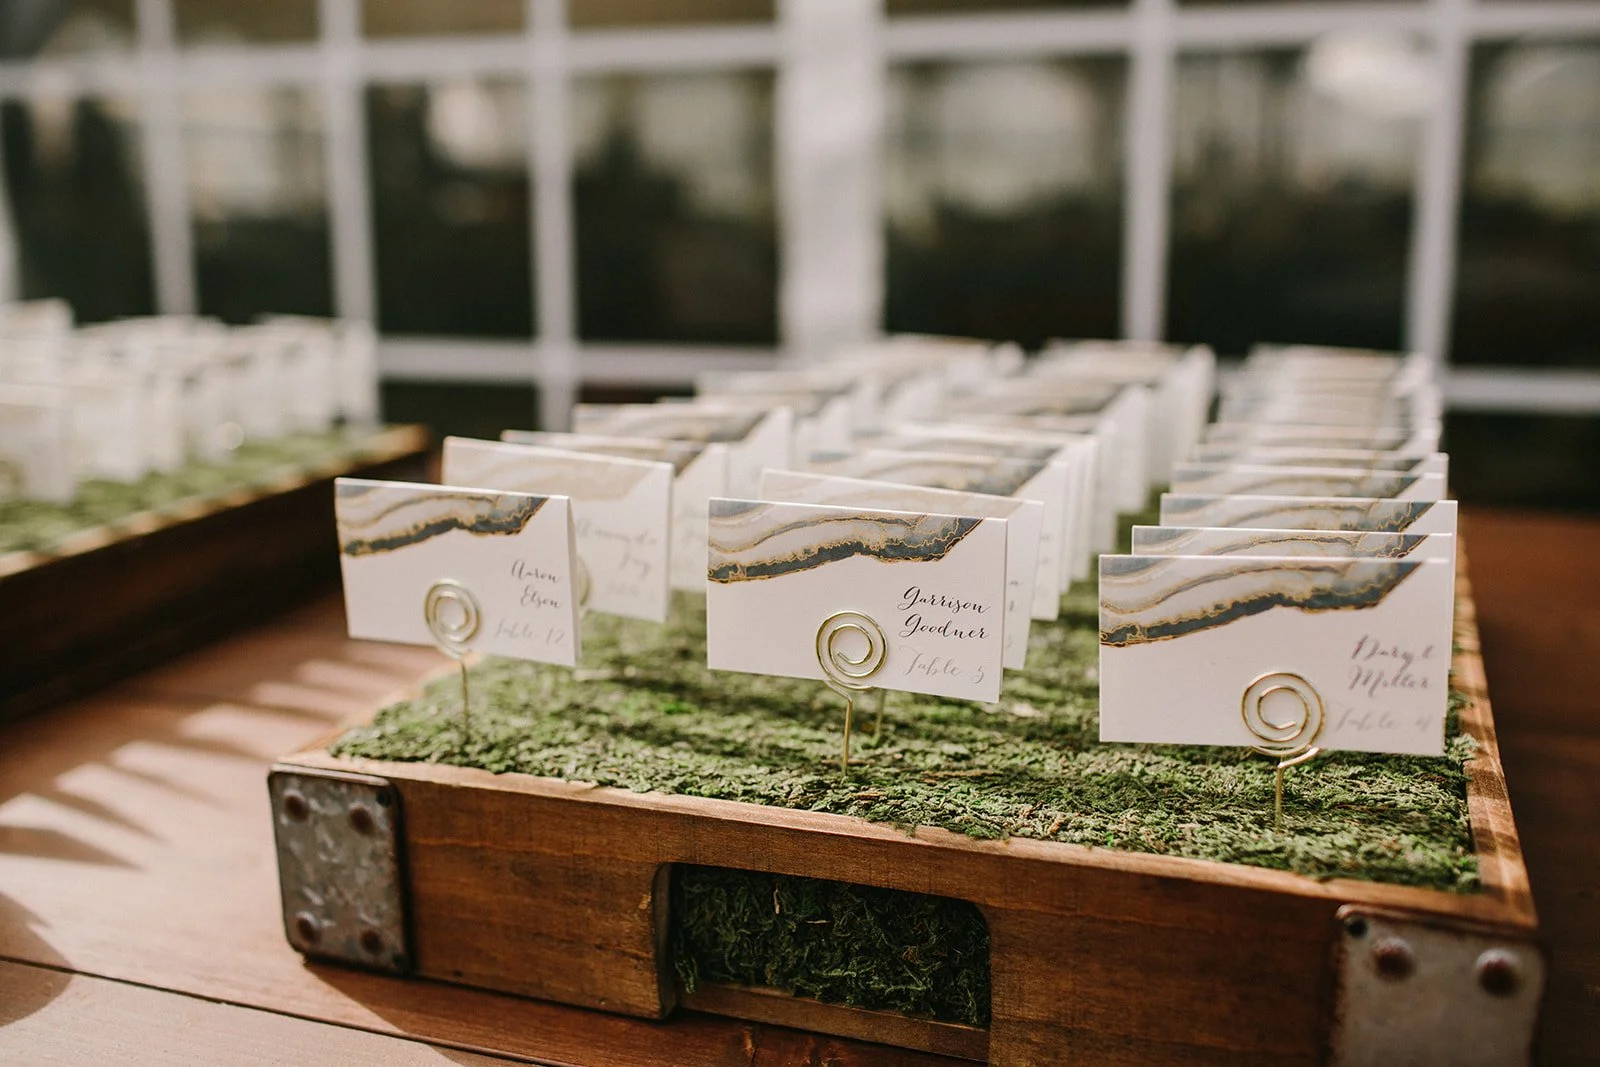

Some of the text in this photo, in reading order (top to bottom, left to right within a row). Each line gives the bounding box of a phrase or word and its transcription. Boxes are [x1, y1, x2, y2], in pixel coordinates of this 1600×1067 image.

[511, 558, 562, 584] Aaron
[897, 585, 992, 614] Garrison
[899, 613, 990, 640] Goodner
[899, 645, 985, 684] Table 5
[1351, 634, 1434, 675] Daryl
